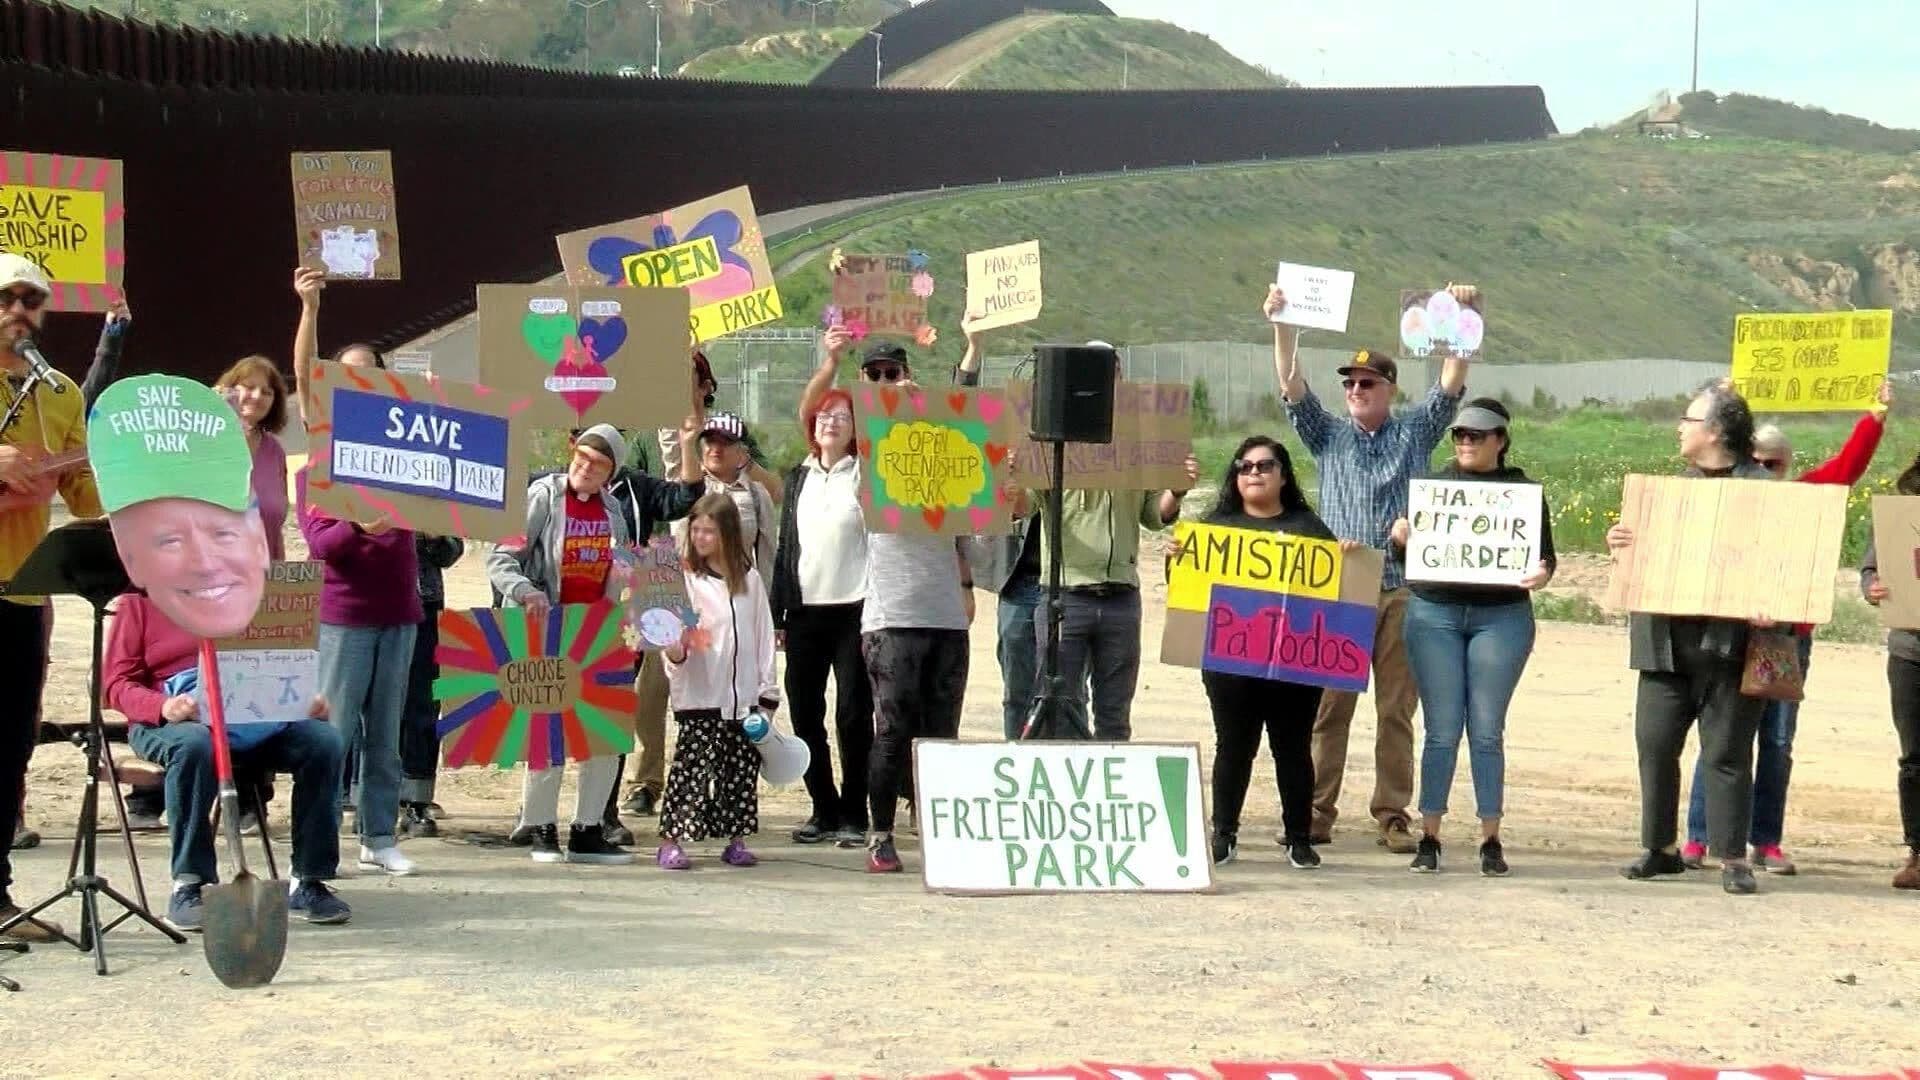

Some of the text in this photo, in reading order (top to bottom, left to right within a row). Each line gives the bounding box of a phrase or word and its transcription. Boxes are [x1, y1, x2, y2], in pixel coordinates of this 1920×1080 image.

[0, 221, 87, 253] ENDSHIP
[629, 240, 718, 287] OPEN
[998, 275, 1017, 290] NO
[720, 289, 779, 331] PARK
[985, 290, 1035, 313] MUROS
[1751, 347, 1785, 372] IS
[137, 385, 182, 406] SAVE
[1786, 377, 1801, 401] A
[109, 407, 226, 438] FRIENDSHIP
[385, 406, 462, 450] SAVE
[143, 433, 190, 453] PARK
[908, 431, 948, 454] OPEN
[338, 447, 499, 493] FRIENDSHIP PARK
[884, 452, 979, 478] FRIENDSHIP
[904, 478, 947, 504] PARK
[567, 517, 610, 537] LOVE
[1471, 513, 1526, 540] OUR
[1176, 530, 1335, 588] AMISTAD
[267, 562, 322, 584] IDEN!
[262, 592, 320, 613] RUMP
[1264, 611, 1360, 673] Todos
[507, 659, 567, 684] CHOOSE
[510, 683, 567, 704] UNITY
[994, 756, 1128, 800] SAVE
[930, 797, 1157, 842] FRIENDSHIP
[1006, 843, 1144, 887] PARK
